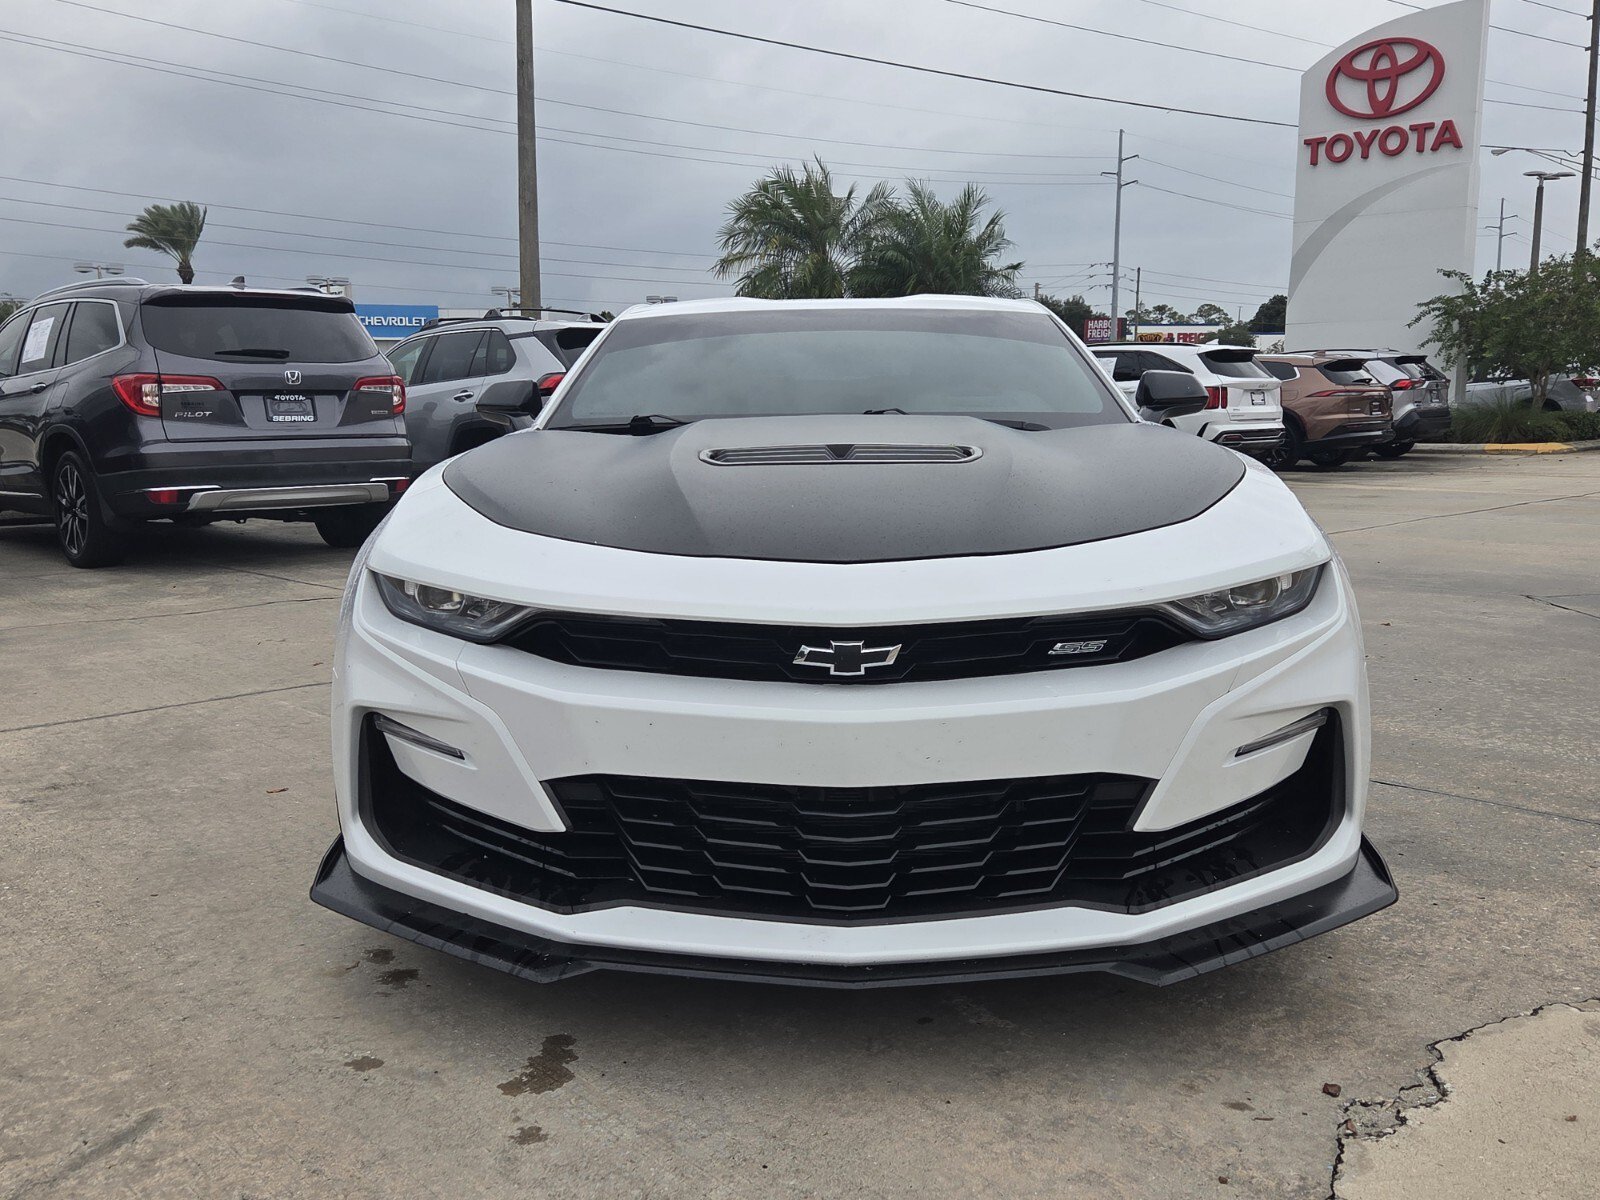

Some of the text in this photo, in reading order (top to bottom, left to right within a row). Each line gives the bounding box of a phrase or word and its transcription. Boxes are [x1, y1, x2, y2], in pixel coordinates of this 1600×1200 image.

[1303, 119, 1463, 166] TOYOTA
[359, 316, 426, 326] CHEVROLET
[1088, 319, 1112, 329] HARBO
[1087, 328, 1112, 338] FREIGH
[1048, 639, 1108, 655] SS
